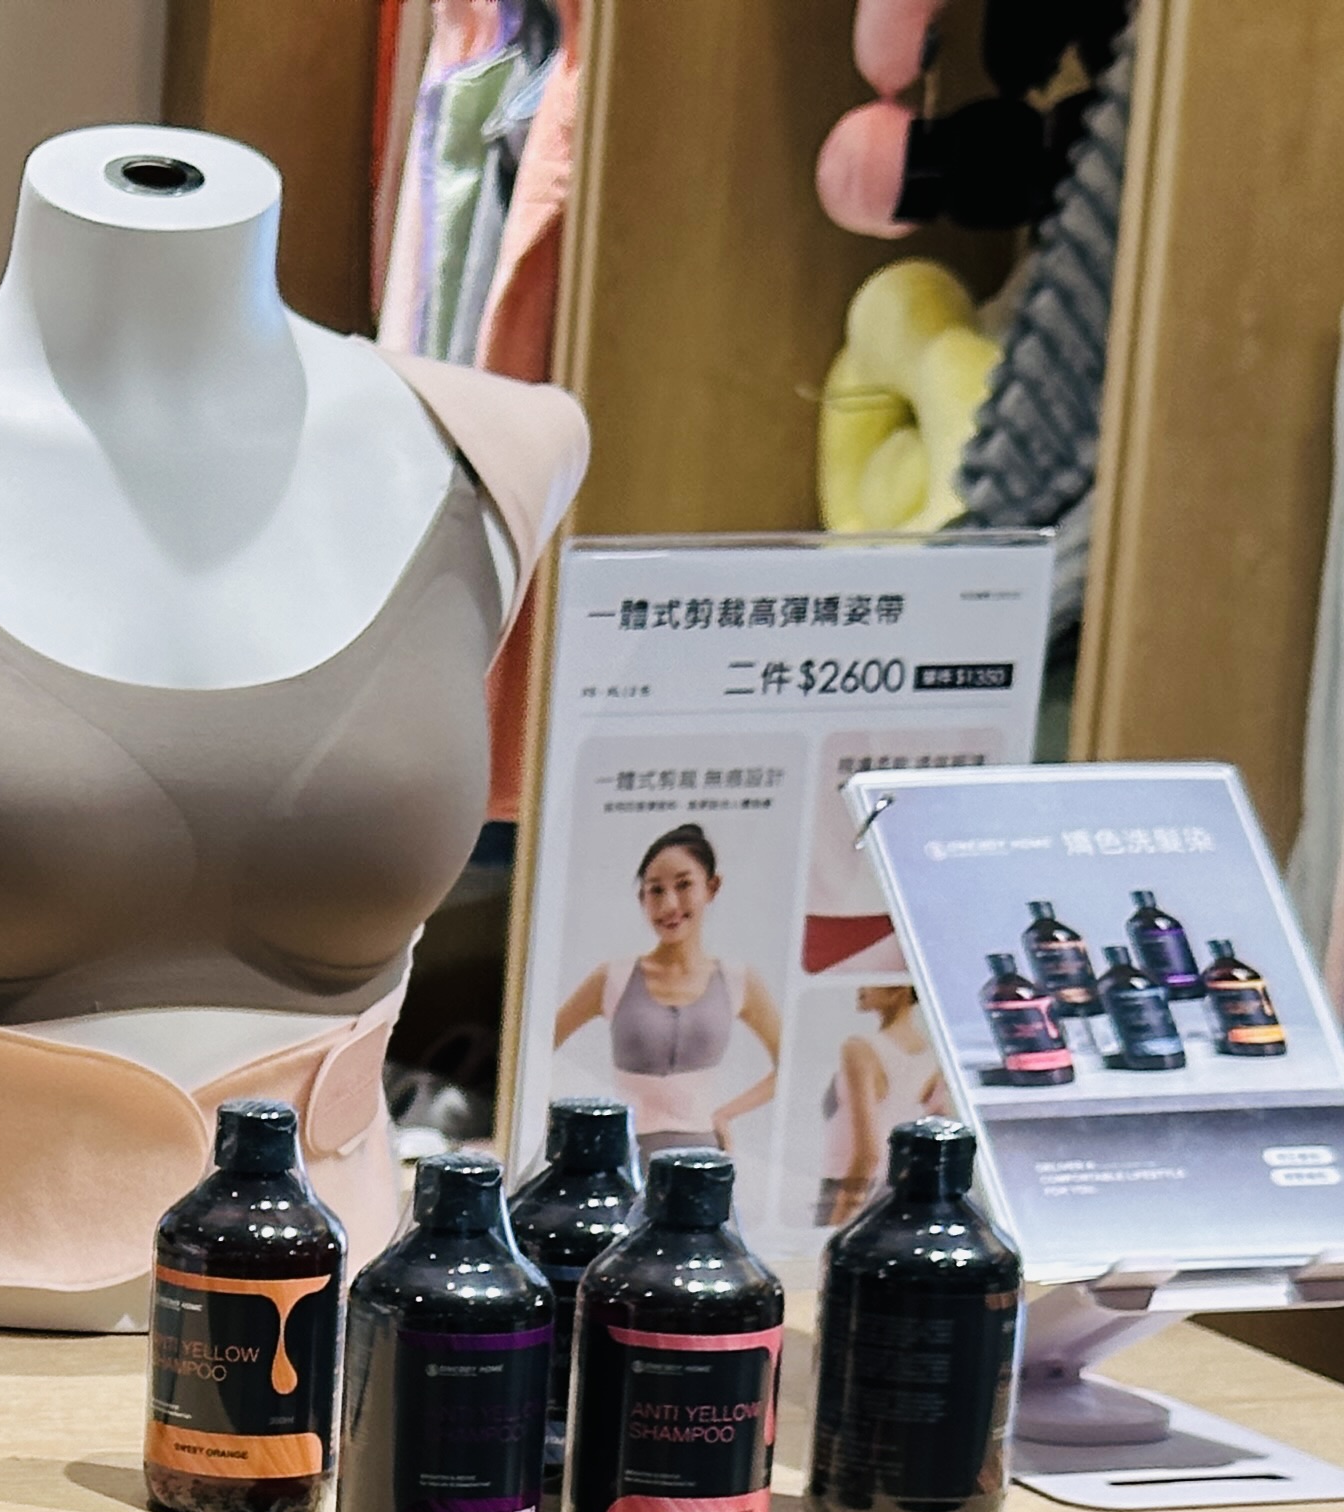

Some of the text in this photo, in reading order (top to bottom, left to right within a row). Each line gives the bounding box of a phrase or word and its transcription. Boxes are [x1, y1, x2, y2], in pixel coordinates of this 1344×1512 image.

[182, 1340, 260, 1363] YELLOW
[631, 1402, 680, 1420] ANTI
[629, 1421, 736, 1444] SHAMPOO
